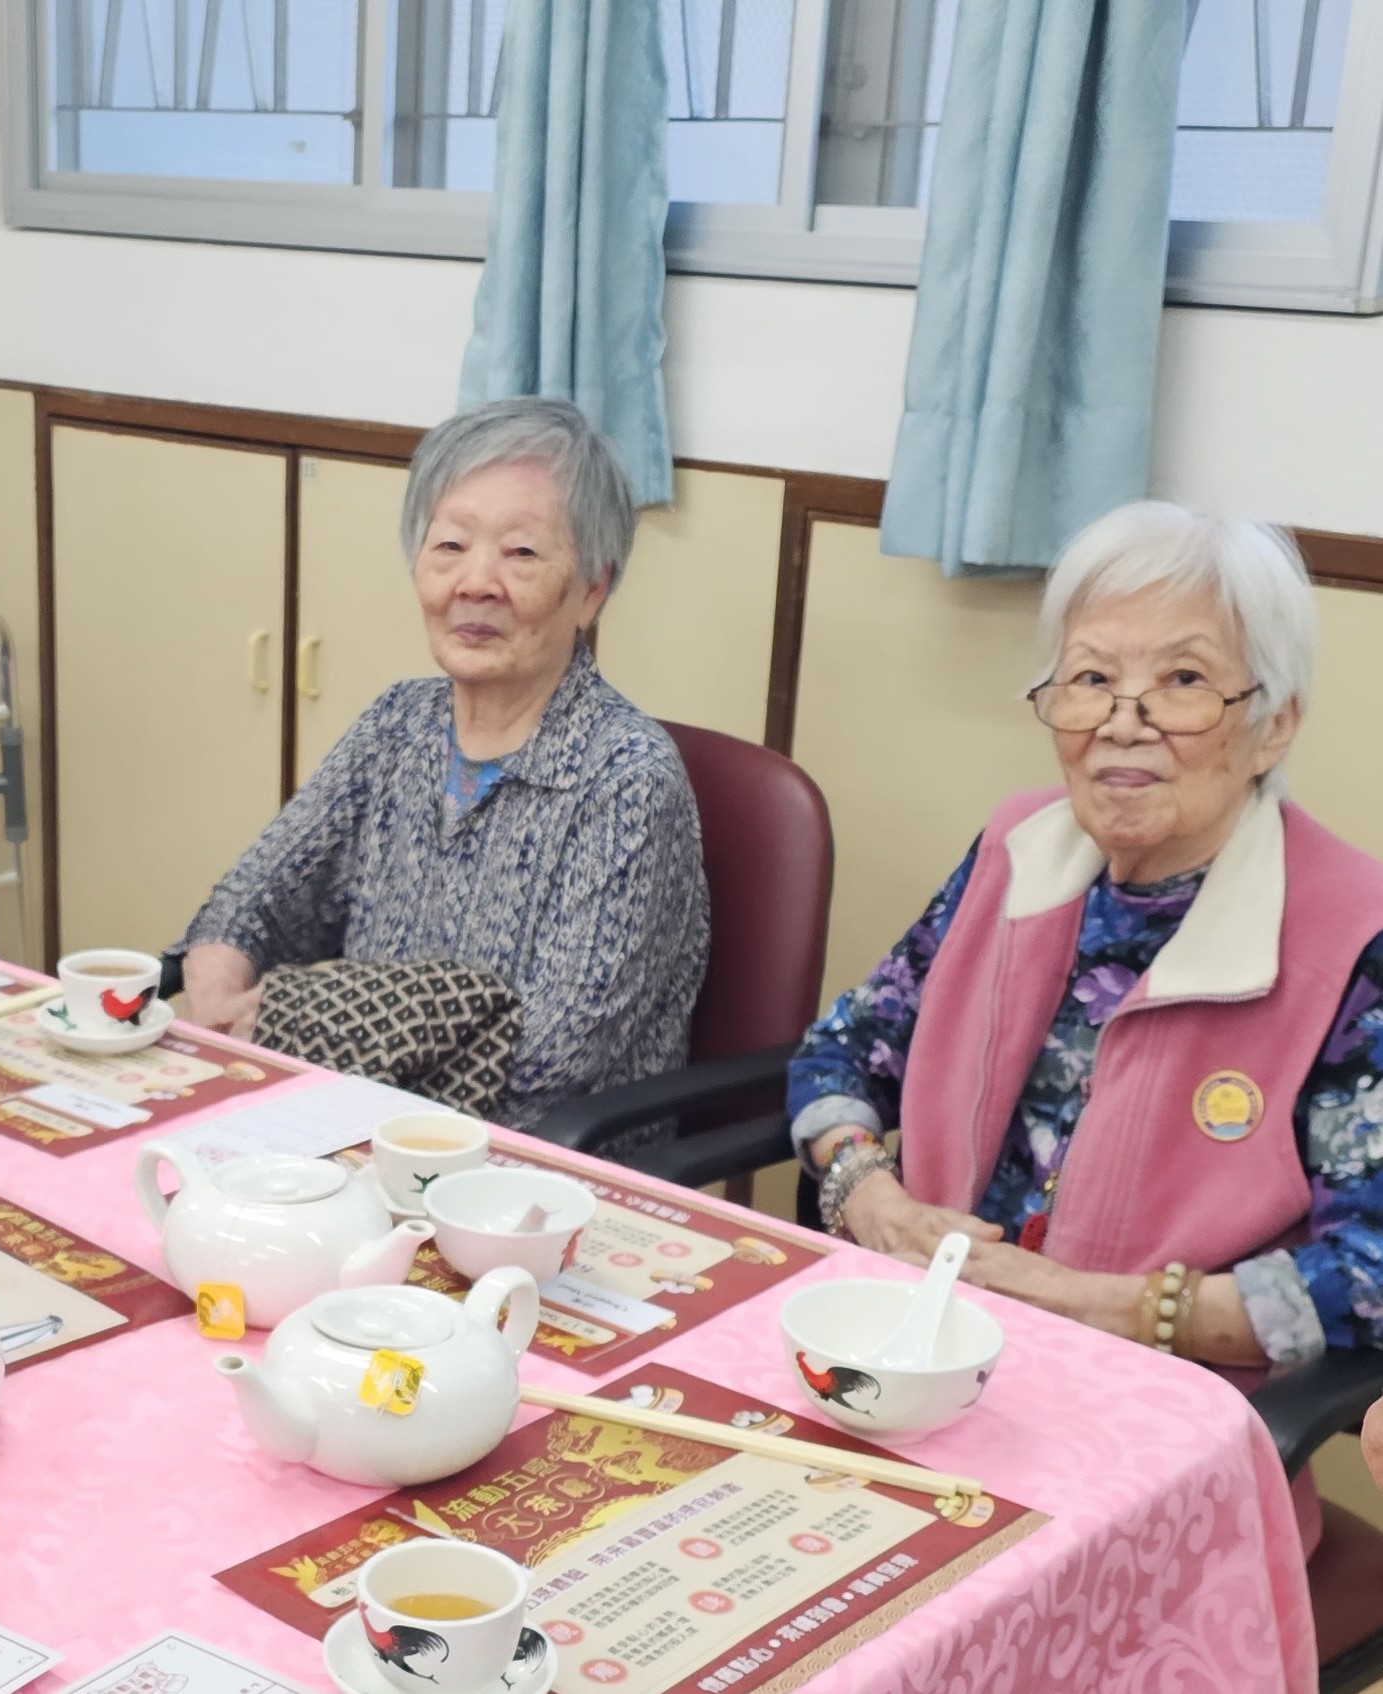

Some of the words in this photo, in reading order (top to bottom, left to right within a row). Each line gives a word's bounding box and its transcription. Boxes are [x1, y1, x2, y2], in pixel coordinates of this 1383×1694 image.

[439, 1457, 563, 1523] 流動五感
[493, 1477, 595, 1537] 大茶樓
